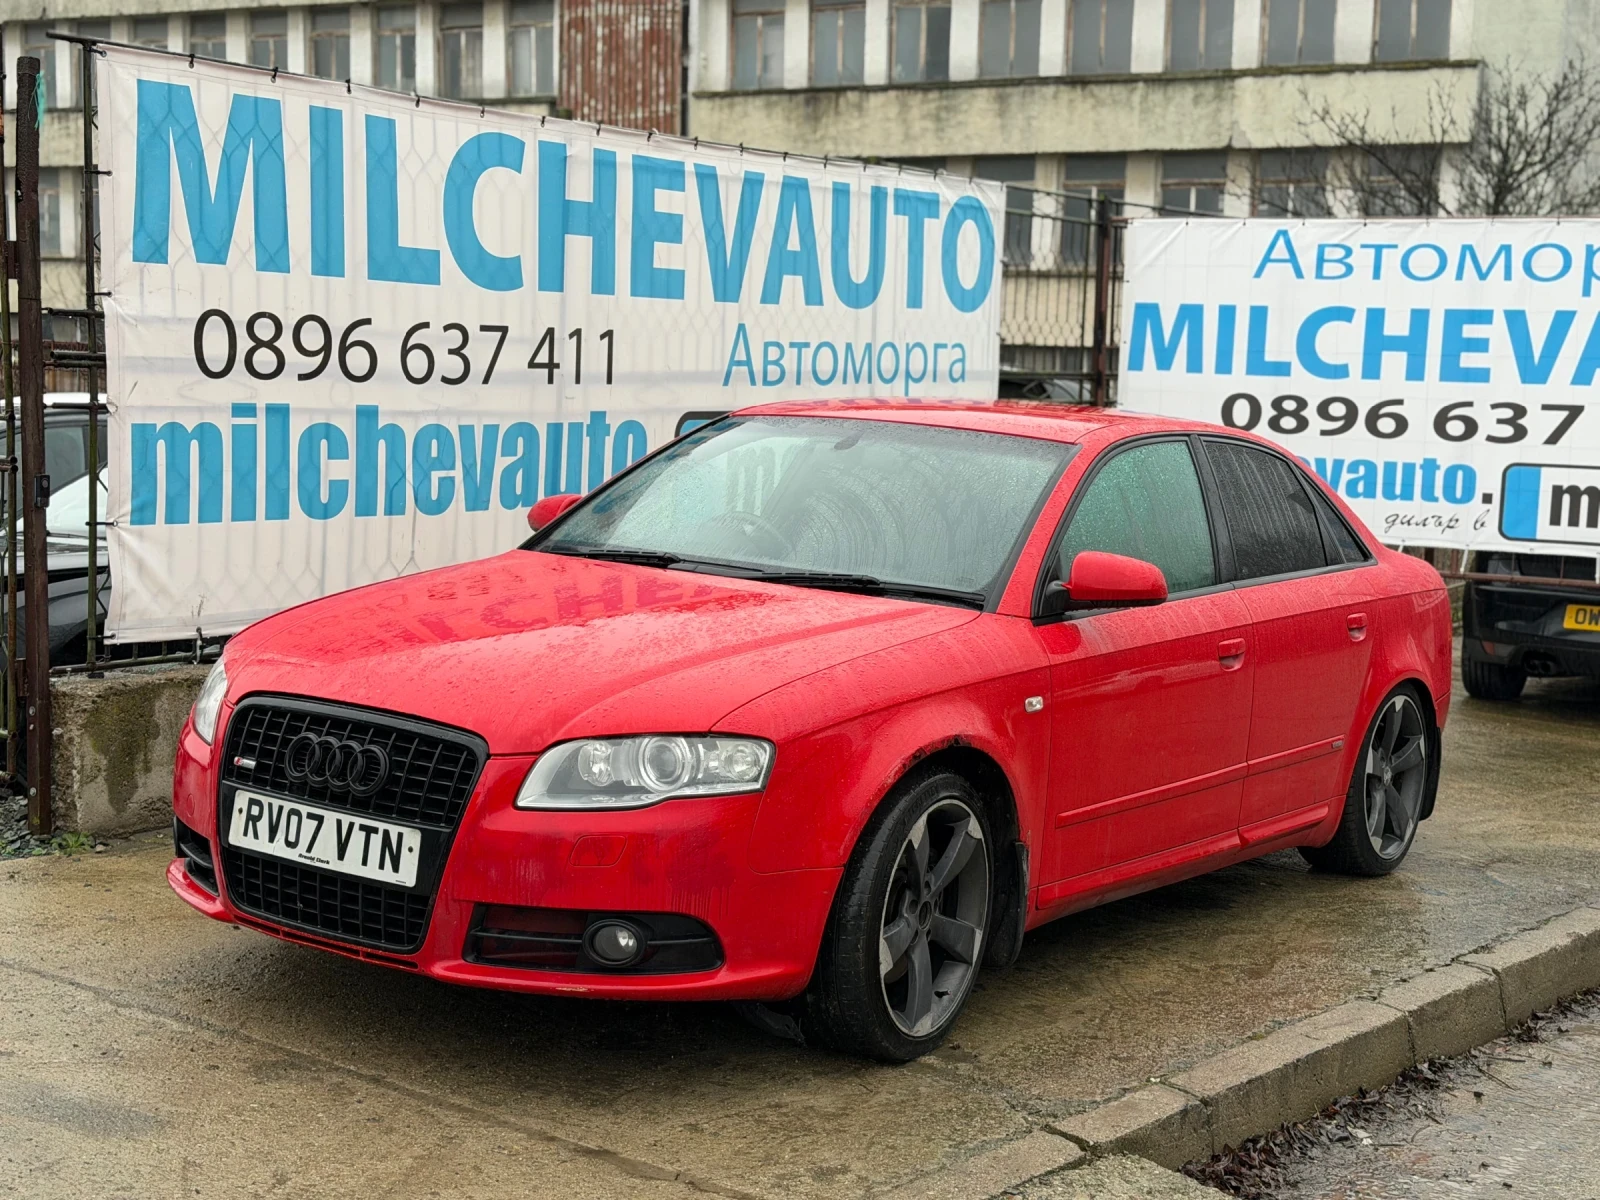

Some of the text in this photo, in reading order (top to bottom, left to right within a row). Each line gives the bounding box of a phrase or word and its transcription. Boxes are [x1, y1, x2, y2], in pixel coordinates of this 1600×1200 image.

[132, 78, 996, 314] MILCHEVAUTO
[194, 308, 616, 386] 0896 637 411
[722, 322, 967, 396] Автоморга
[1220, 392, 1586, 446] 0896 637
[129, 402, 648, 526] milchevauto
[1296, 456, 1493, 505] vauto.
[242, 798, 405, 874] RV07 VTN
